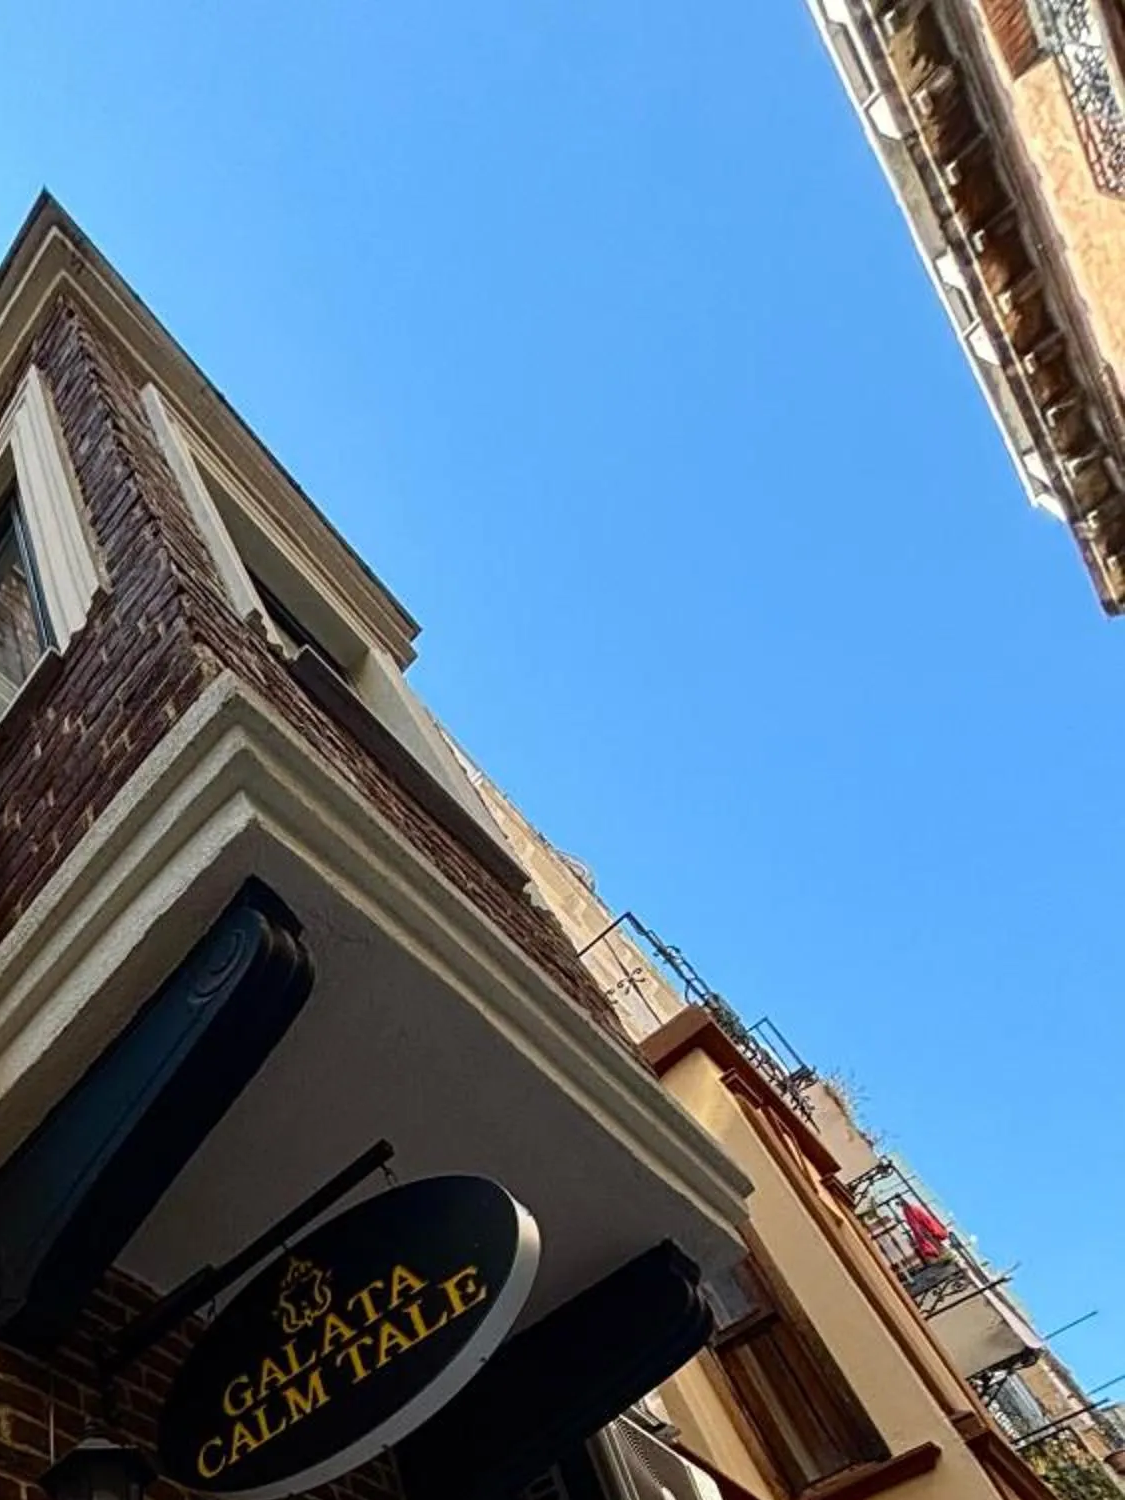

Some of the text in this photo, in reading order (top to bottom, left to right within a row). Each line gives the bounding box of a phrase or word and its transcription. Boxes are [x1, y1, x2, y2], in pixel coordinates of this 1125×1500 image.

[195, 1265, 488, 1479] CALM TALE
[221, 1263, 429, 1418] GALATA
